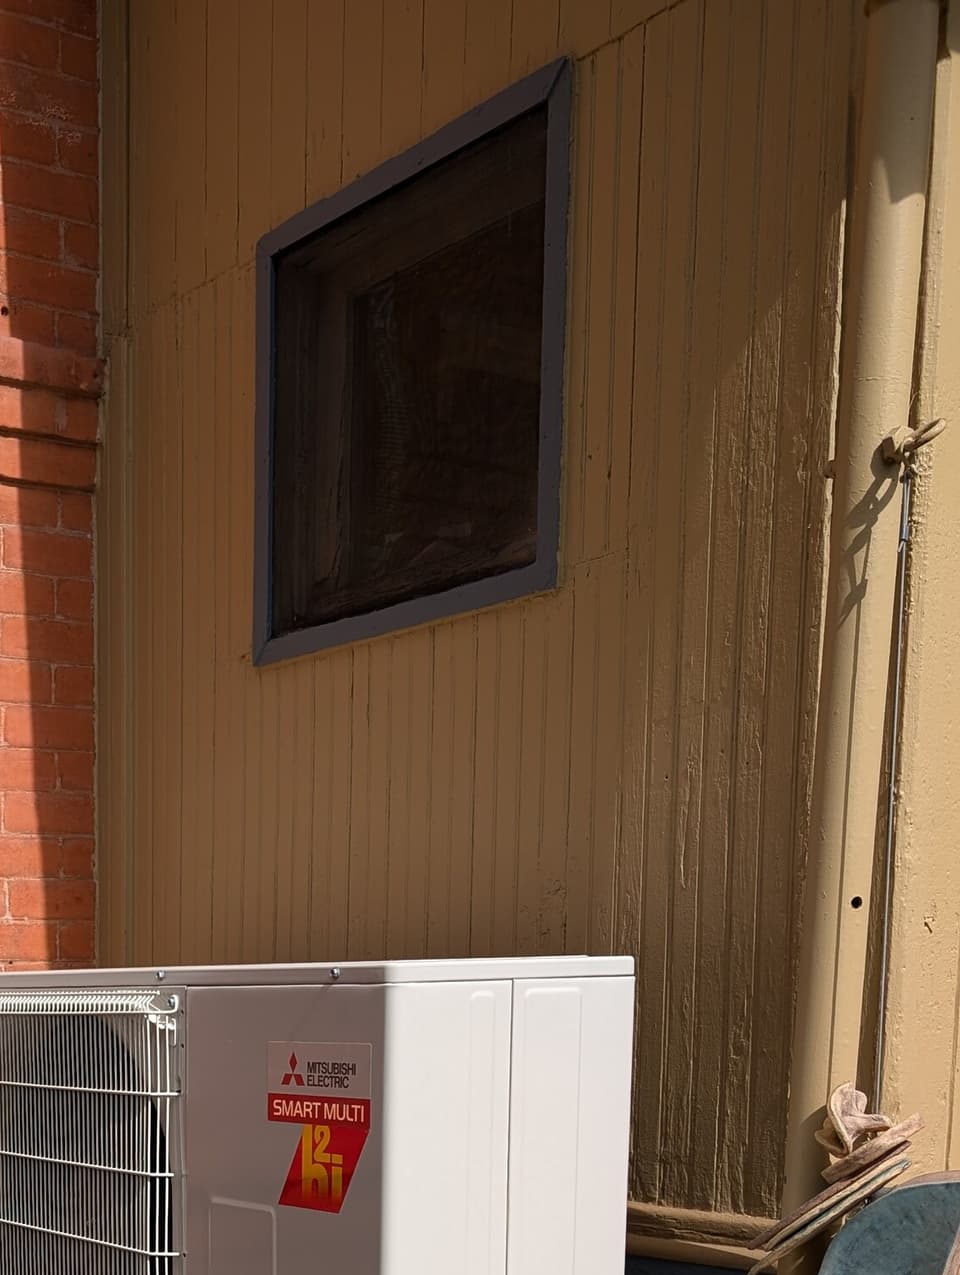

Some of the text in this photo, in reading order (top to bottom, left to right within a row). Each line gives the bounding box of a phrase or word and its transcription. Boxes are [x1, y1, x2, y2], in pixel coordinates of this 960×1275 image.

[307, 1062, 356, 1076] MITSUBISHI
[307, 1075, 349, 1088] ELECTRIC
[273, 1099, 365, 1122] SMART MULTI
